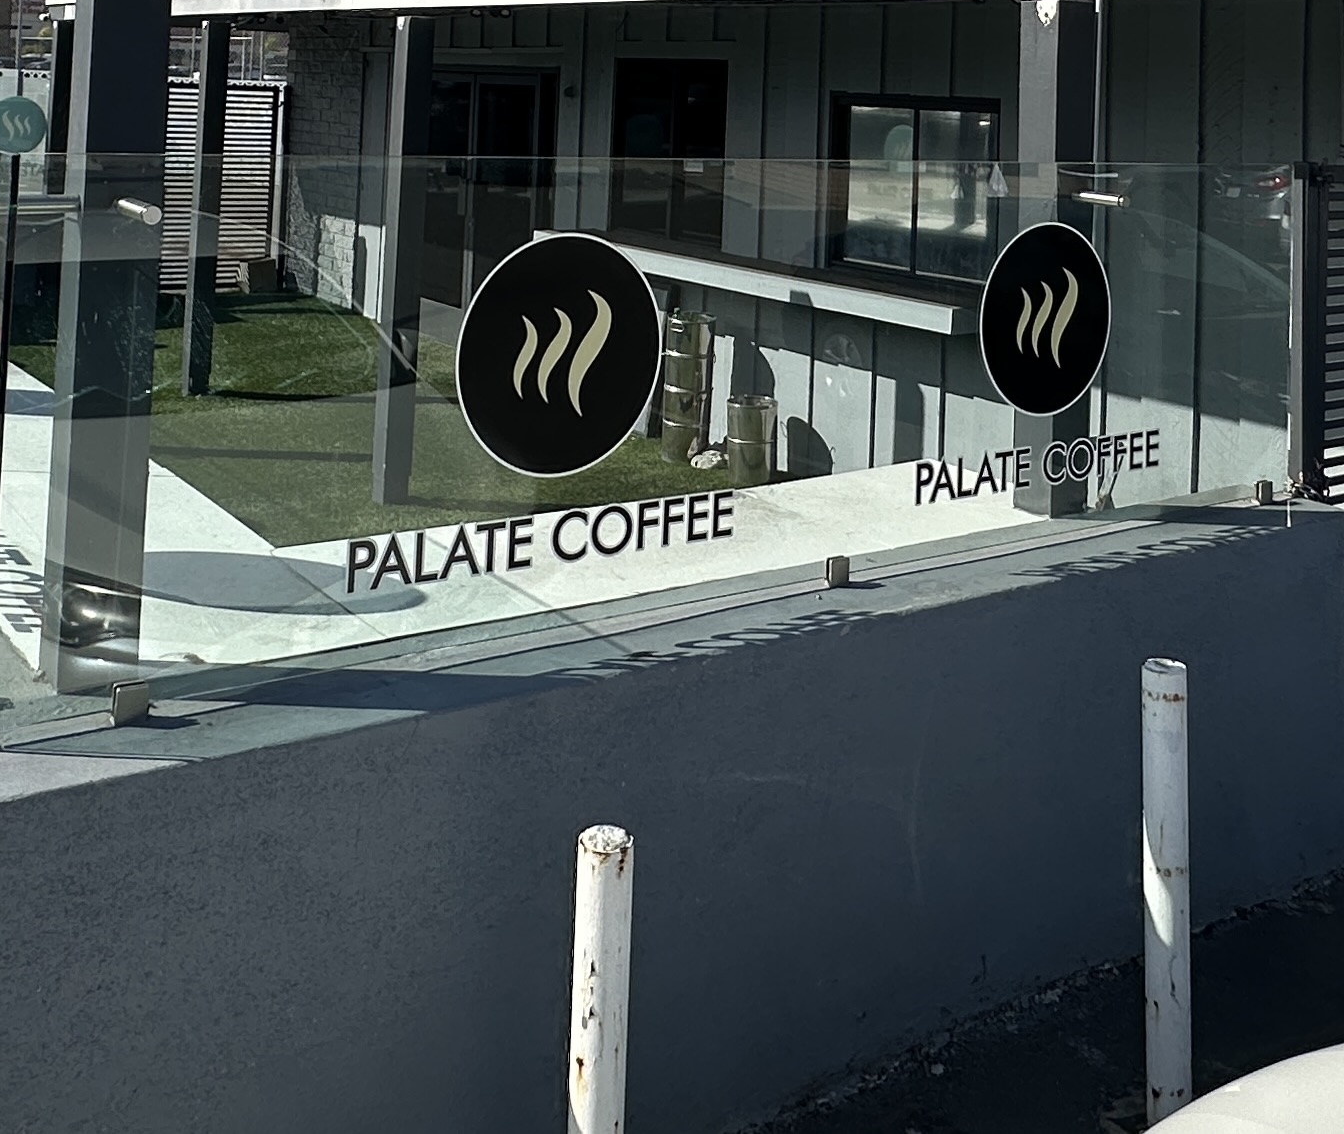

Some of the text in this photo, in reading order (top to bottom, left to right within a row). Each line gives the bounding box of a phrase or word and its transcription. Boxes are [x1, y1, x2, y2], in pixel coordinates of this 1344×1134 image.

[913, 428, 1160, 507] PALATE COFFEE
[346, 490, 735, 594] PALATE COFFEE
